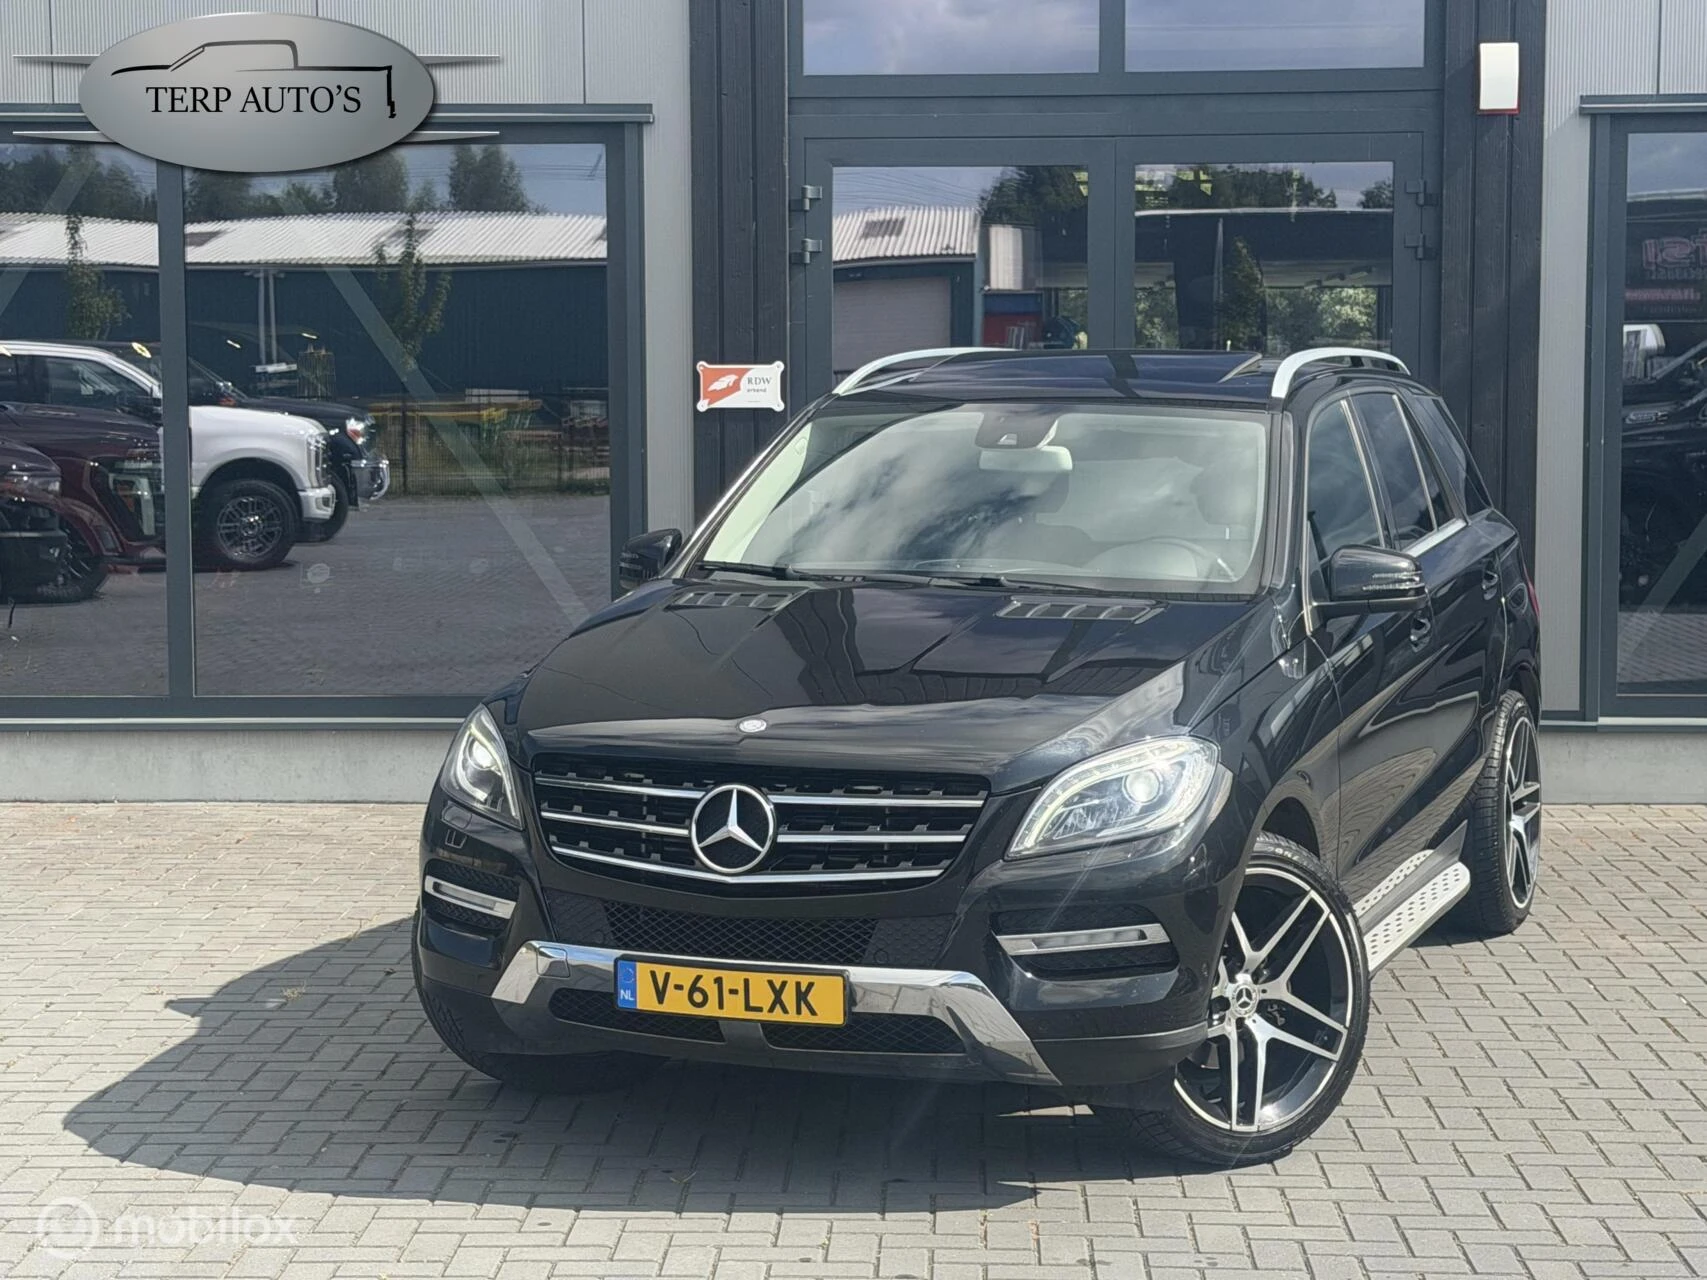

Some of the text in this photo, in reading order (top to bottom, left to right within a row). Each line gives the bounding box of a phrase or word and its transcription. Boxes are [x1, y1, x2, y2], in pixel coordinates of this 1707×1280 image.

[747, 376, 771, 385] RDW
[620, 989, 634, 1001] NL
[649, 969, 819, 1017] V-61-LXK
